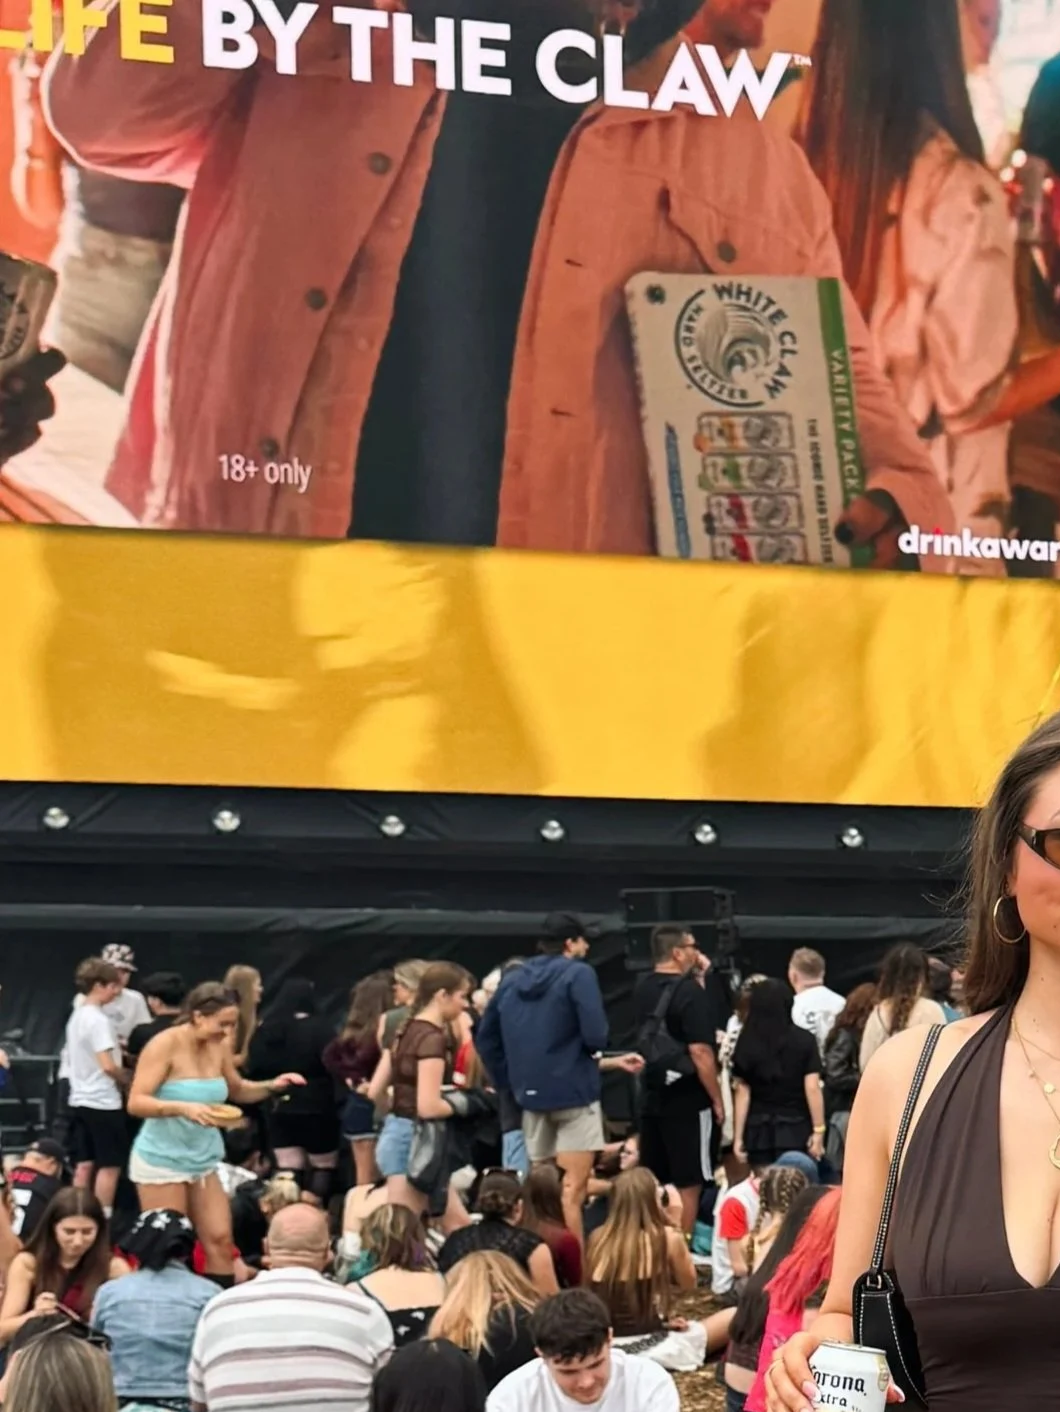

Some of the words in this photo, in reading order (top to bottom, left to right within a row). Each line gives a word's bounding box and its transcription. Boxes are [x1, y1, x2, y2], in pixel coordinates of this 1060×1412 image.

[0, 0, 174, 63] IFE
[202, 0, 319, 75] BY
[332, 6, 511, 96] THE
[712, 281, 788, 326] WHITE
[763, 331, 798, 399] CLAW
[831, 350, 852, 432] VARIETY
[218, 453, 259, 482] 18+
[264, 457, 312, 493] only
[841, 438, 859, 489] PACK
[812, 1367, 866, 1394] orona
[819, 1392, 848, 1408] xtra
